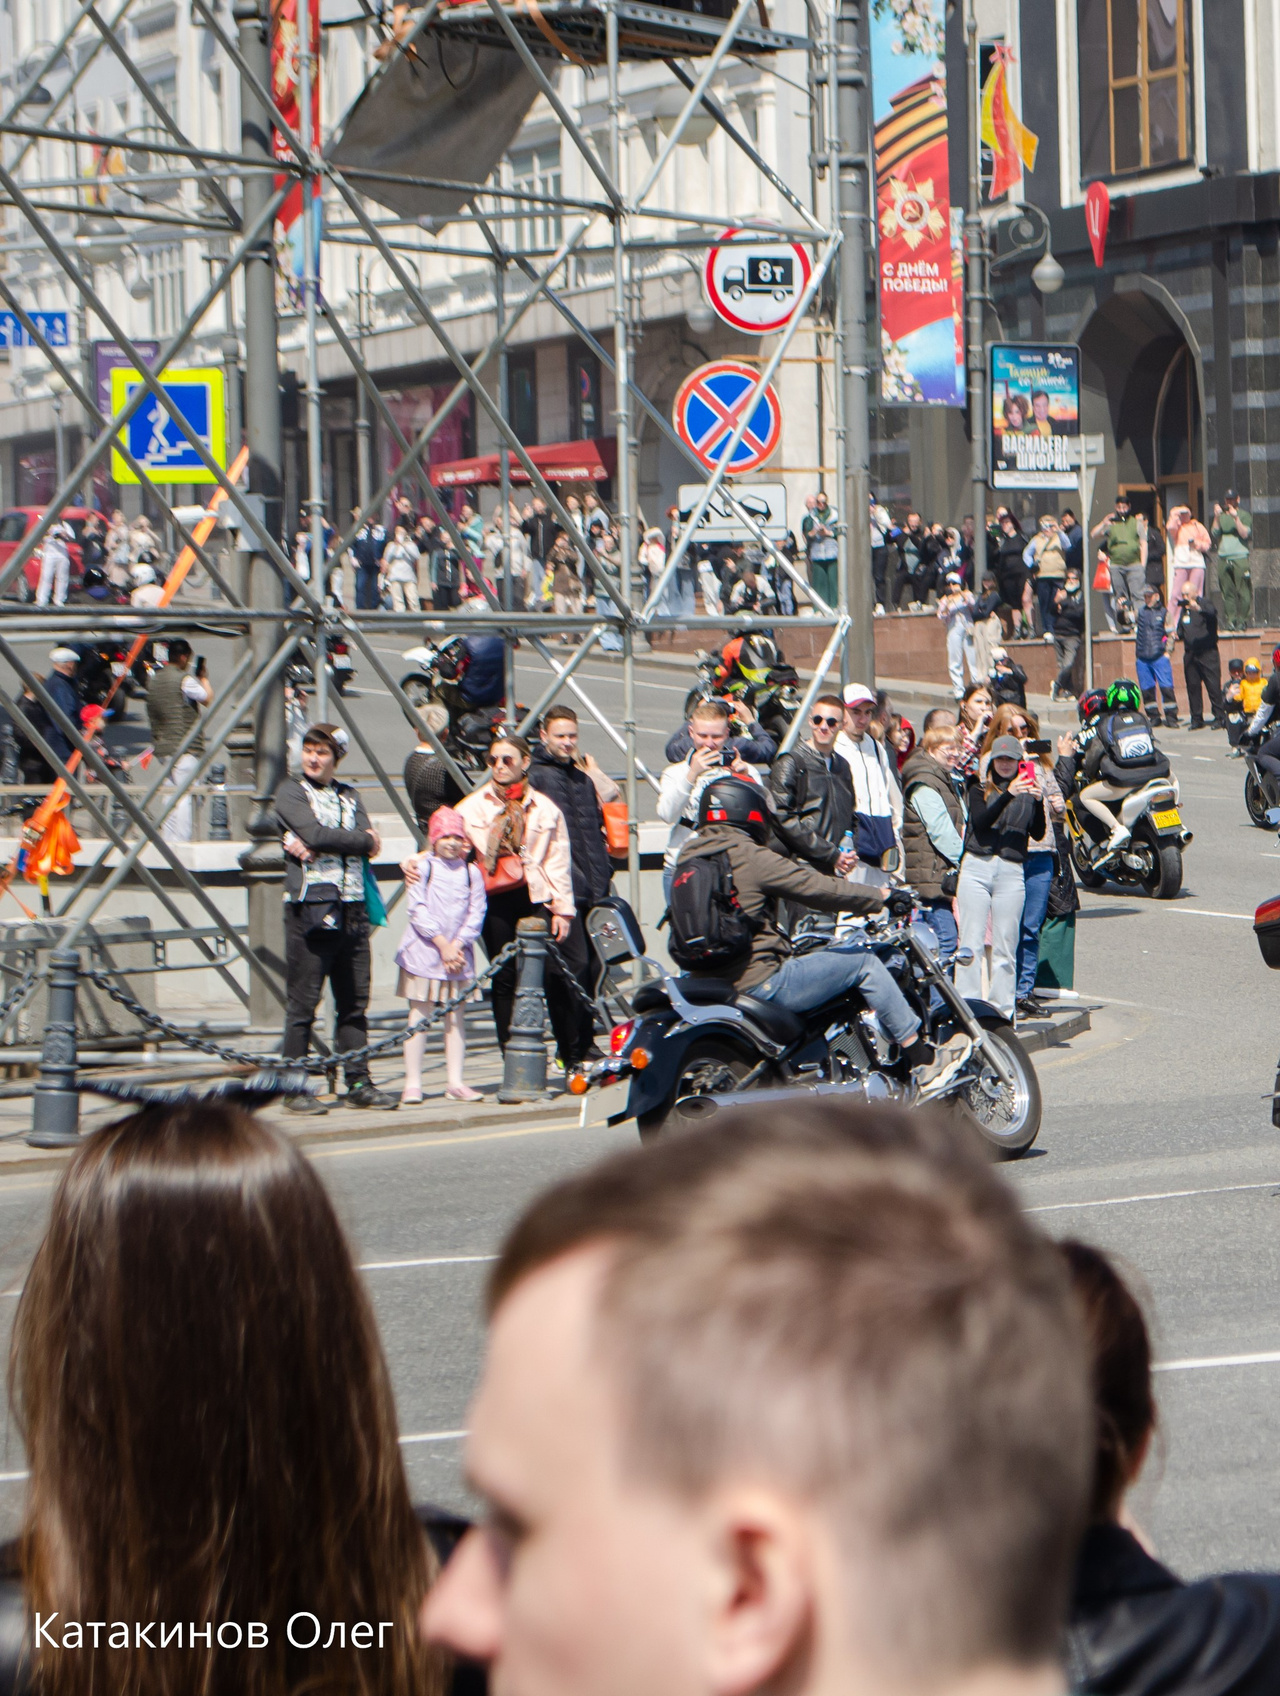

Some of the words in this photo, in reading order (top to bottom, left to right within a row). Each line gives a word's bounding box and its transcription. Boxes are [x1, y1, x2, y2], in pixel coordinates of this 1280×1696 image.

[883, 262, 894, 276] С
[897, 260, 939, 278] ДНЁМ
[883, 278, 948, 294] ПОБЕДЫ!
